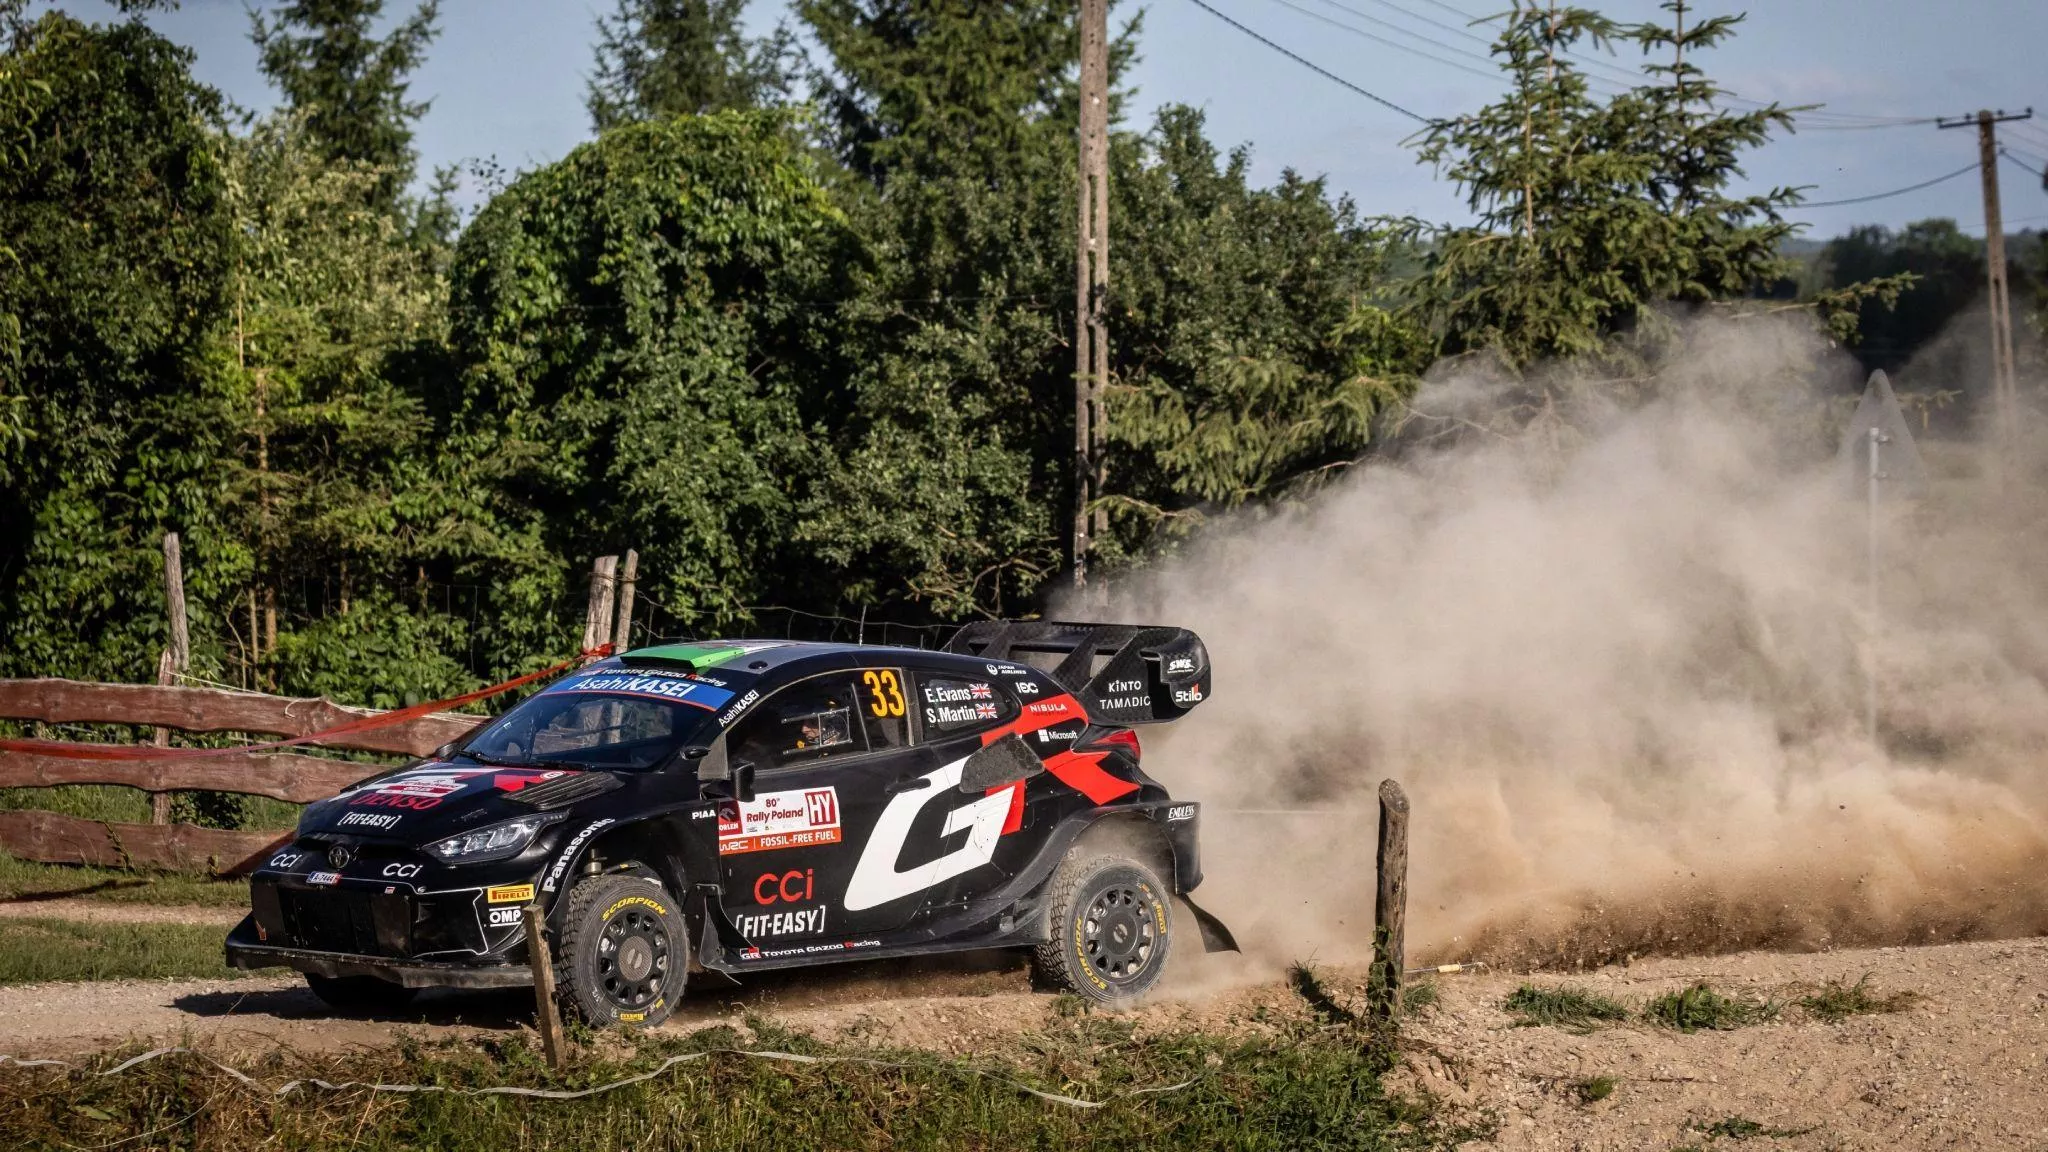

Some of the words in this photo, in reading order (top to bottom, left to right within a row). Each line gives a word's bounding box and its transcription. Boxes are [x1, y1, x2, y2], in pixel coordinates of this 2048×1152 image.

[568, 677, 698, 698] AsahiKASEI
[687, 673, 728, 687] Racing
[864, 670, 905, 717] 33
[925, 687, 971, 703] E.Evans
[1175, 683, 1203, 702] Stilo
[717, 689, 760, 727] AsahiKASEI
[1029, 704, 1068, 712] NISULA
[1099, 696, 1151, 710] TAMADIC
[926, 703, 977, 723] S.Martin
[1048, 729, 1078, 740] Microsoft
[350, 793, 443, 810] DENSO
[807, 792, 834, 824] HY
[692, 809, 716, 820] PIAA
[746, 811, 770, 823] Rally
[771, 808, 804, 820] Poland
[1168, 805, 1195, 819] ENDLESS
[719, 823, 738, 831] ORLEN
[720, 840, 749, 851] WRC
[760, 832, 813, 847] FOSSIL-FREE
[815, 831, 836, 841] FUEL
[542, 818, 615, 892] Panasonic
[492, 887, 530, 900] PIRELLI
[489, 909, 521, 924] OMP
[602, 897, 666, 921] SCORPION
[764, 948, 804, 958] TOYOTA
[806, 944, 845, 953] GAZOO
[845, 940, 881, 949] Racing
[1075, 916, 1108, 990] SCORPION
